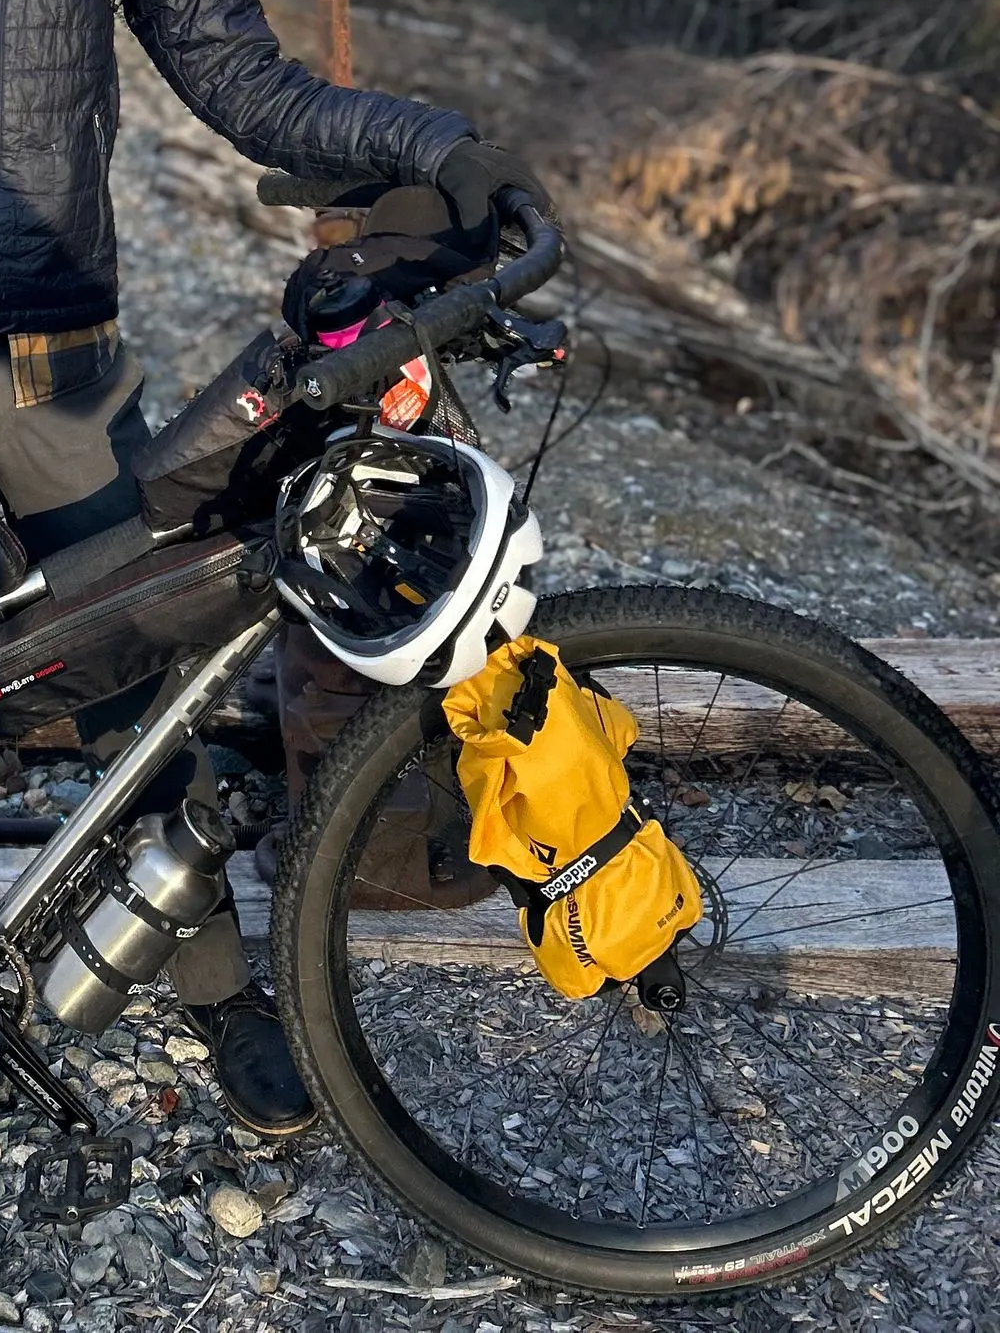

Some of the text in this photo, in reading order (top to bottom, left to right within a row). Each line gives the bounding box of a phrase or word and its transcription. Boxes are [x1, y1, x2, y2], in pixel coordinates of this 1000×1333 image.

[492, 585, 509, 609] BELL
[567, 902, 598, 968] SUMMIT
[829, 1045, 999, 1236] vittoria MEZCAL
